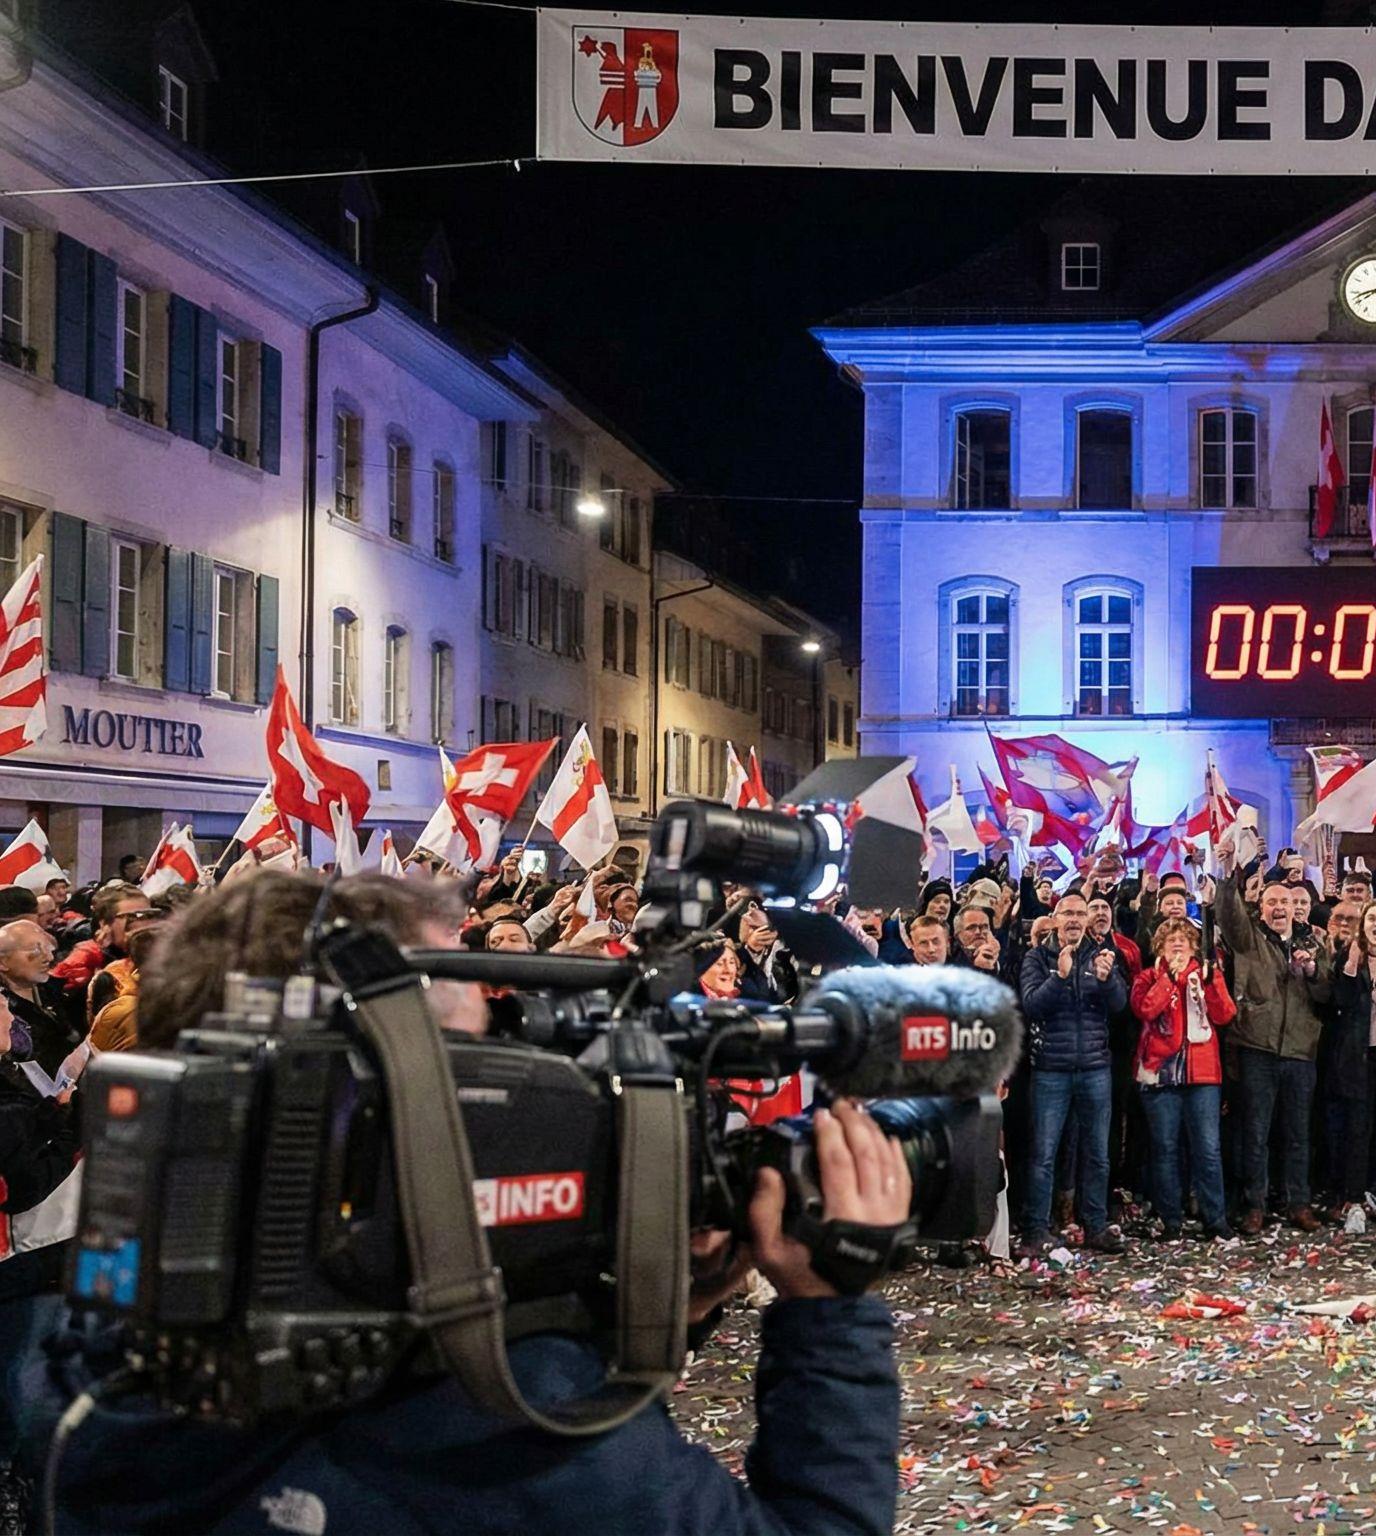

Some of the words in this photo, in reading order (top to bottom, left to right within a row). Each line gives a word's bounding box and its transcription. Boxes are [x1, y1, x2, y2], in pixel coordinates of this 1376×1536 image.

[713, 48, 1271, 141] BIENVENUE
[60, 704, 205, 758] MOUTIER
[907, 1026, 947, 1050] RTS
[951, 1019, 996, 1050] Info
[498, 1177, 579, 1222] INFO
